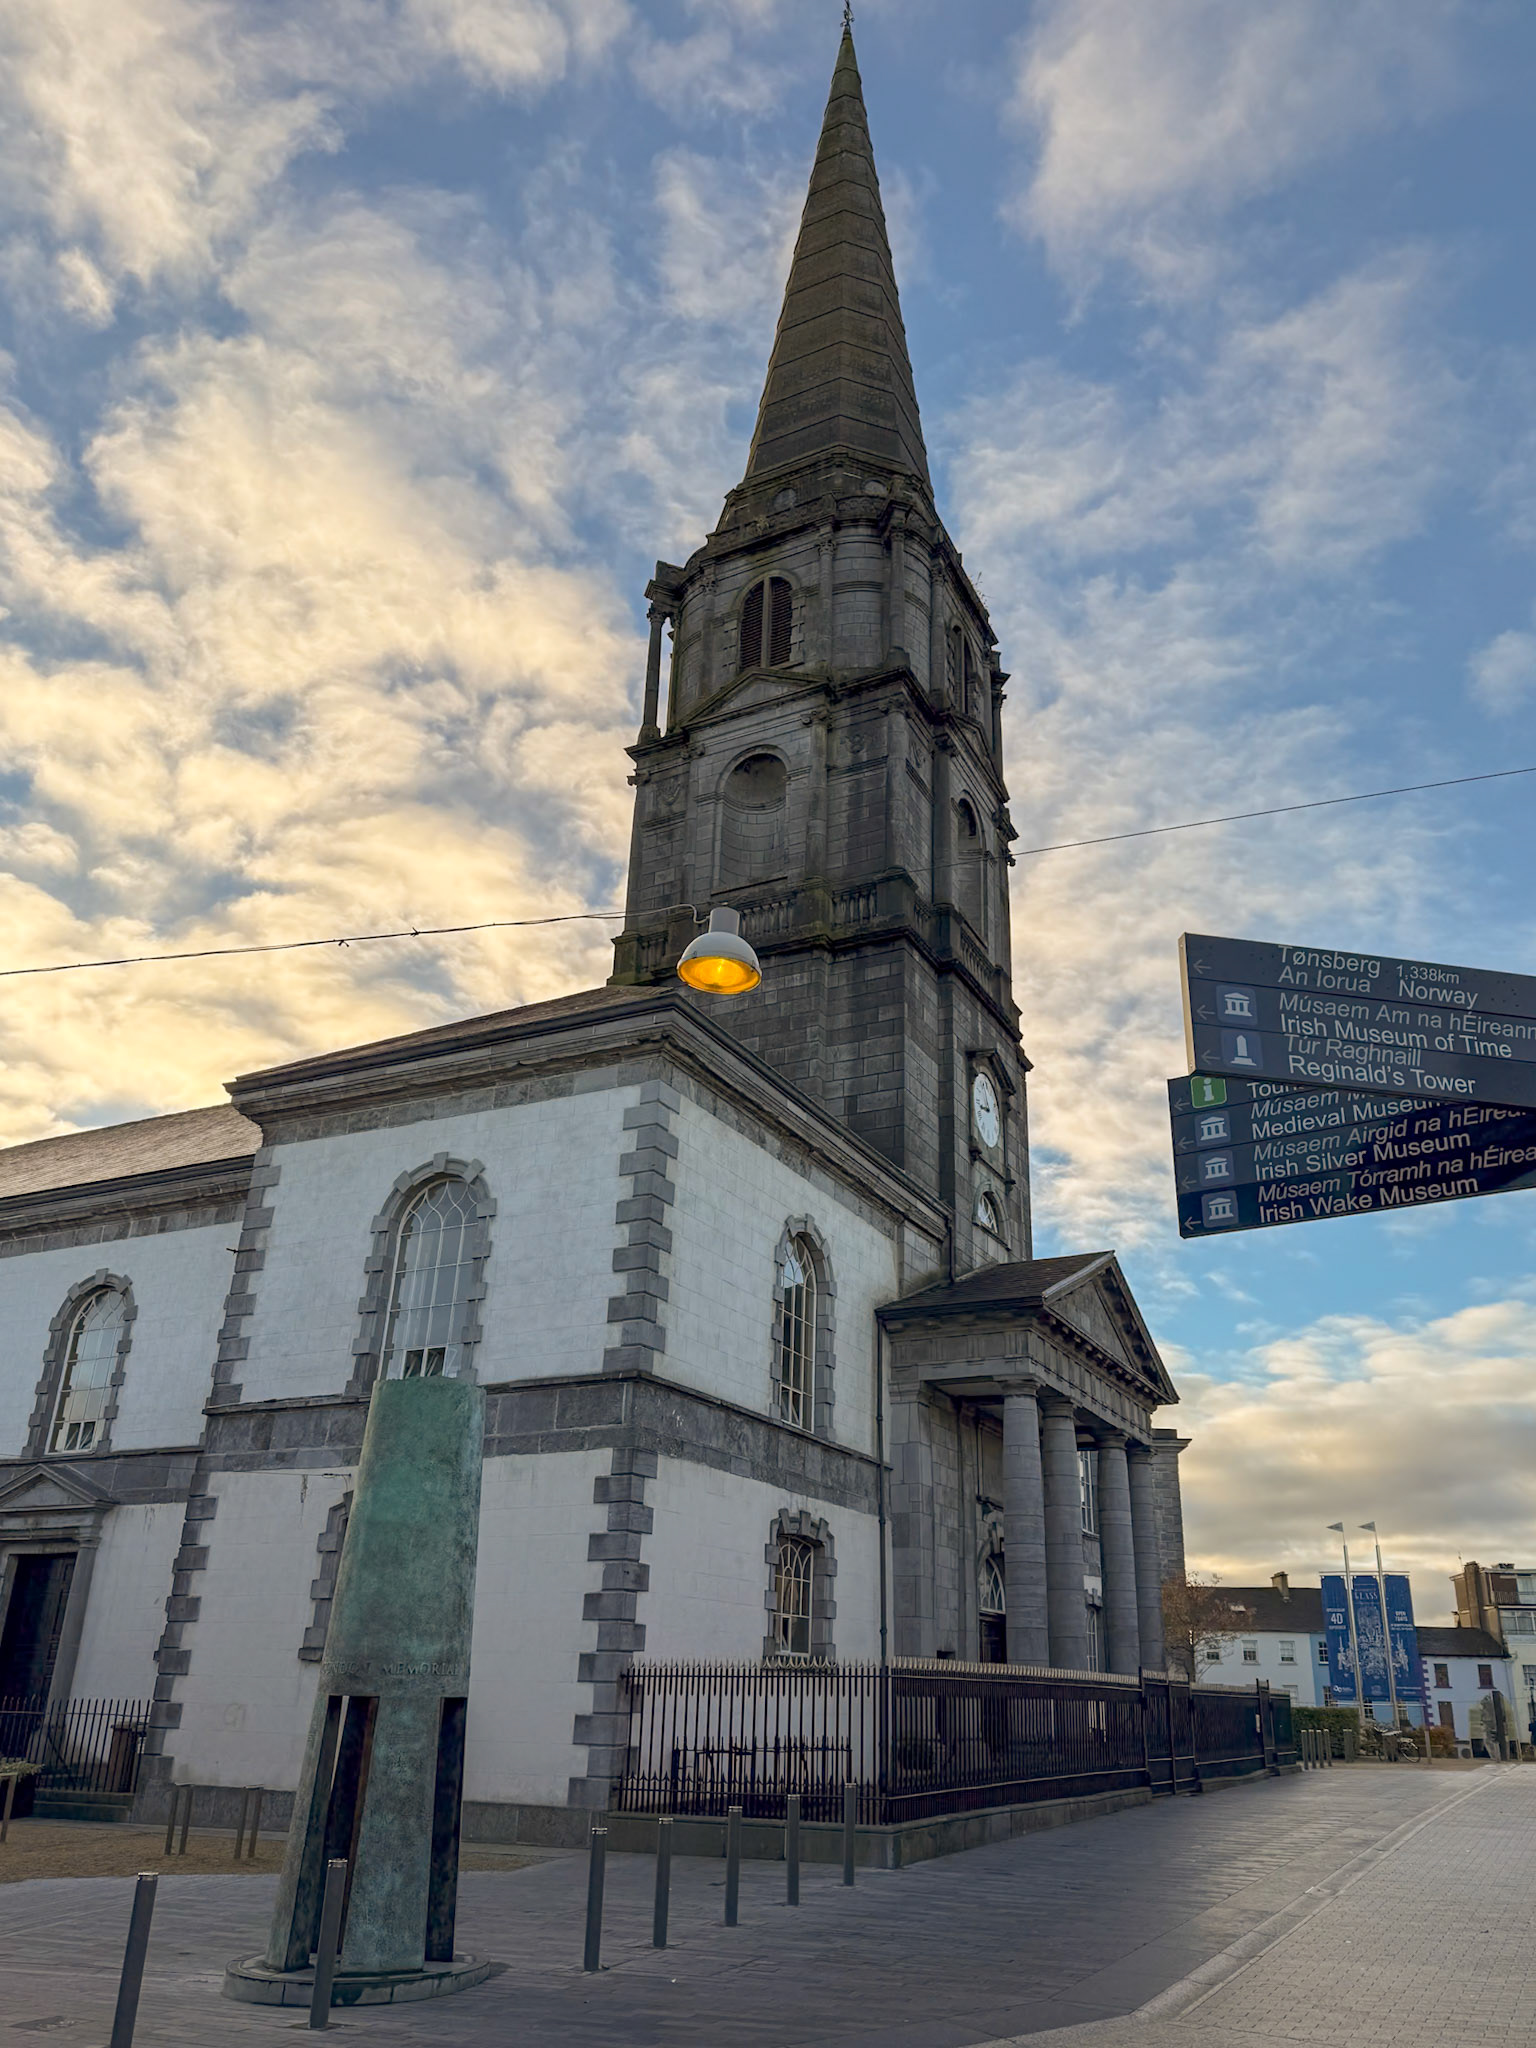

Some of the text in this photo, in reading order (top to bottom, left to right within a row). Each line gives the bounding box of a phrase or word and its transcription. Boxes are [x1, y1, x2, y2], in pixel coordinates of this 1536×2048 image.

[1278, 945, 1380, 978] Tønsberg
[1278, 965, 1479, 1010] An Iorua Norway
[1279, 992, 1536, 1041] Músaem Am na hÉireann
[1280, 1014, 1512, 1058] Irish Museum of Time
[1284, 1033, 1421, 1067] Túr Raghnaill
[1410, 1068, 1476, 1094] Tower
[1251, 1091, 1339, 1120] Músaem
[1252, 1099, 1446, 1140] Medieval Museu
[1253, 1135, 1340, 1161] Músaem
[1345, 1119, 1408, 1146] Airgid
[1414, 1117, 1441, 1135] na
[1255, 1132, 1471, 1181] Irish Silver Museum
[1258, 1178, 1341, 1203] Músaem
[1347, 1160, 1431, 1189] Tórramh
[1437, 1158, 1463, 1175] na
[1260, 1177, 1478, 1223] Irish Wake Museum
[1330, 1613, 1344, 1625] 4D
